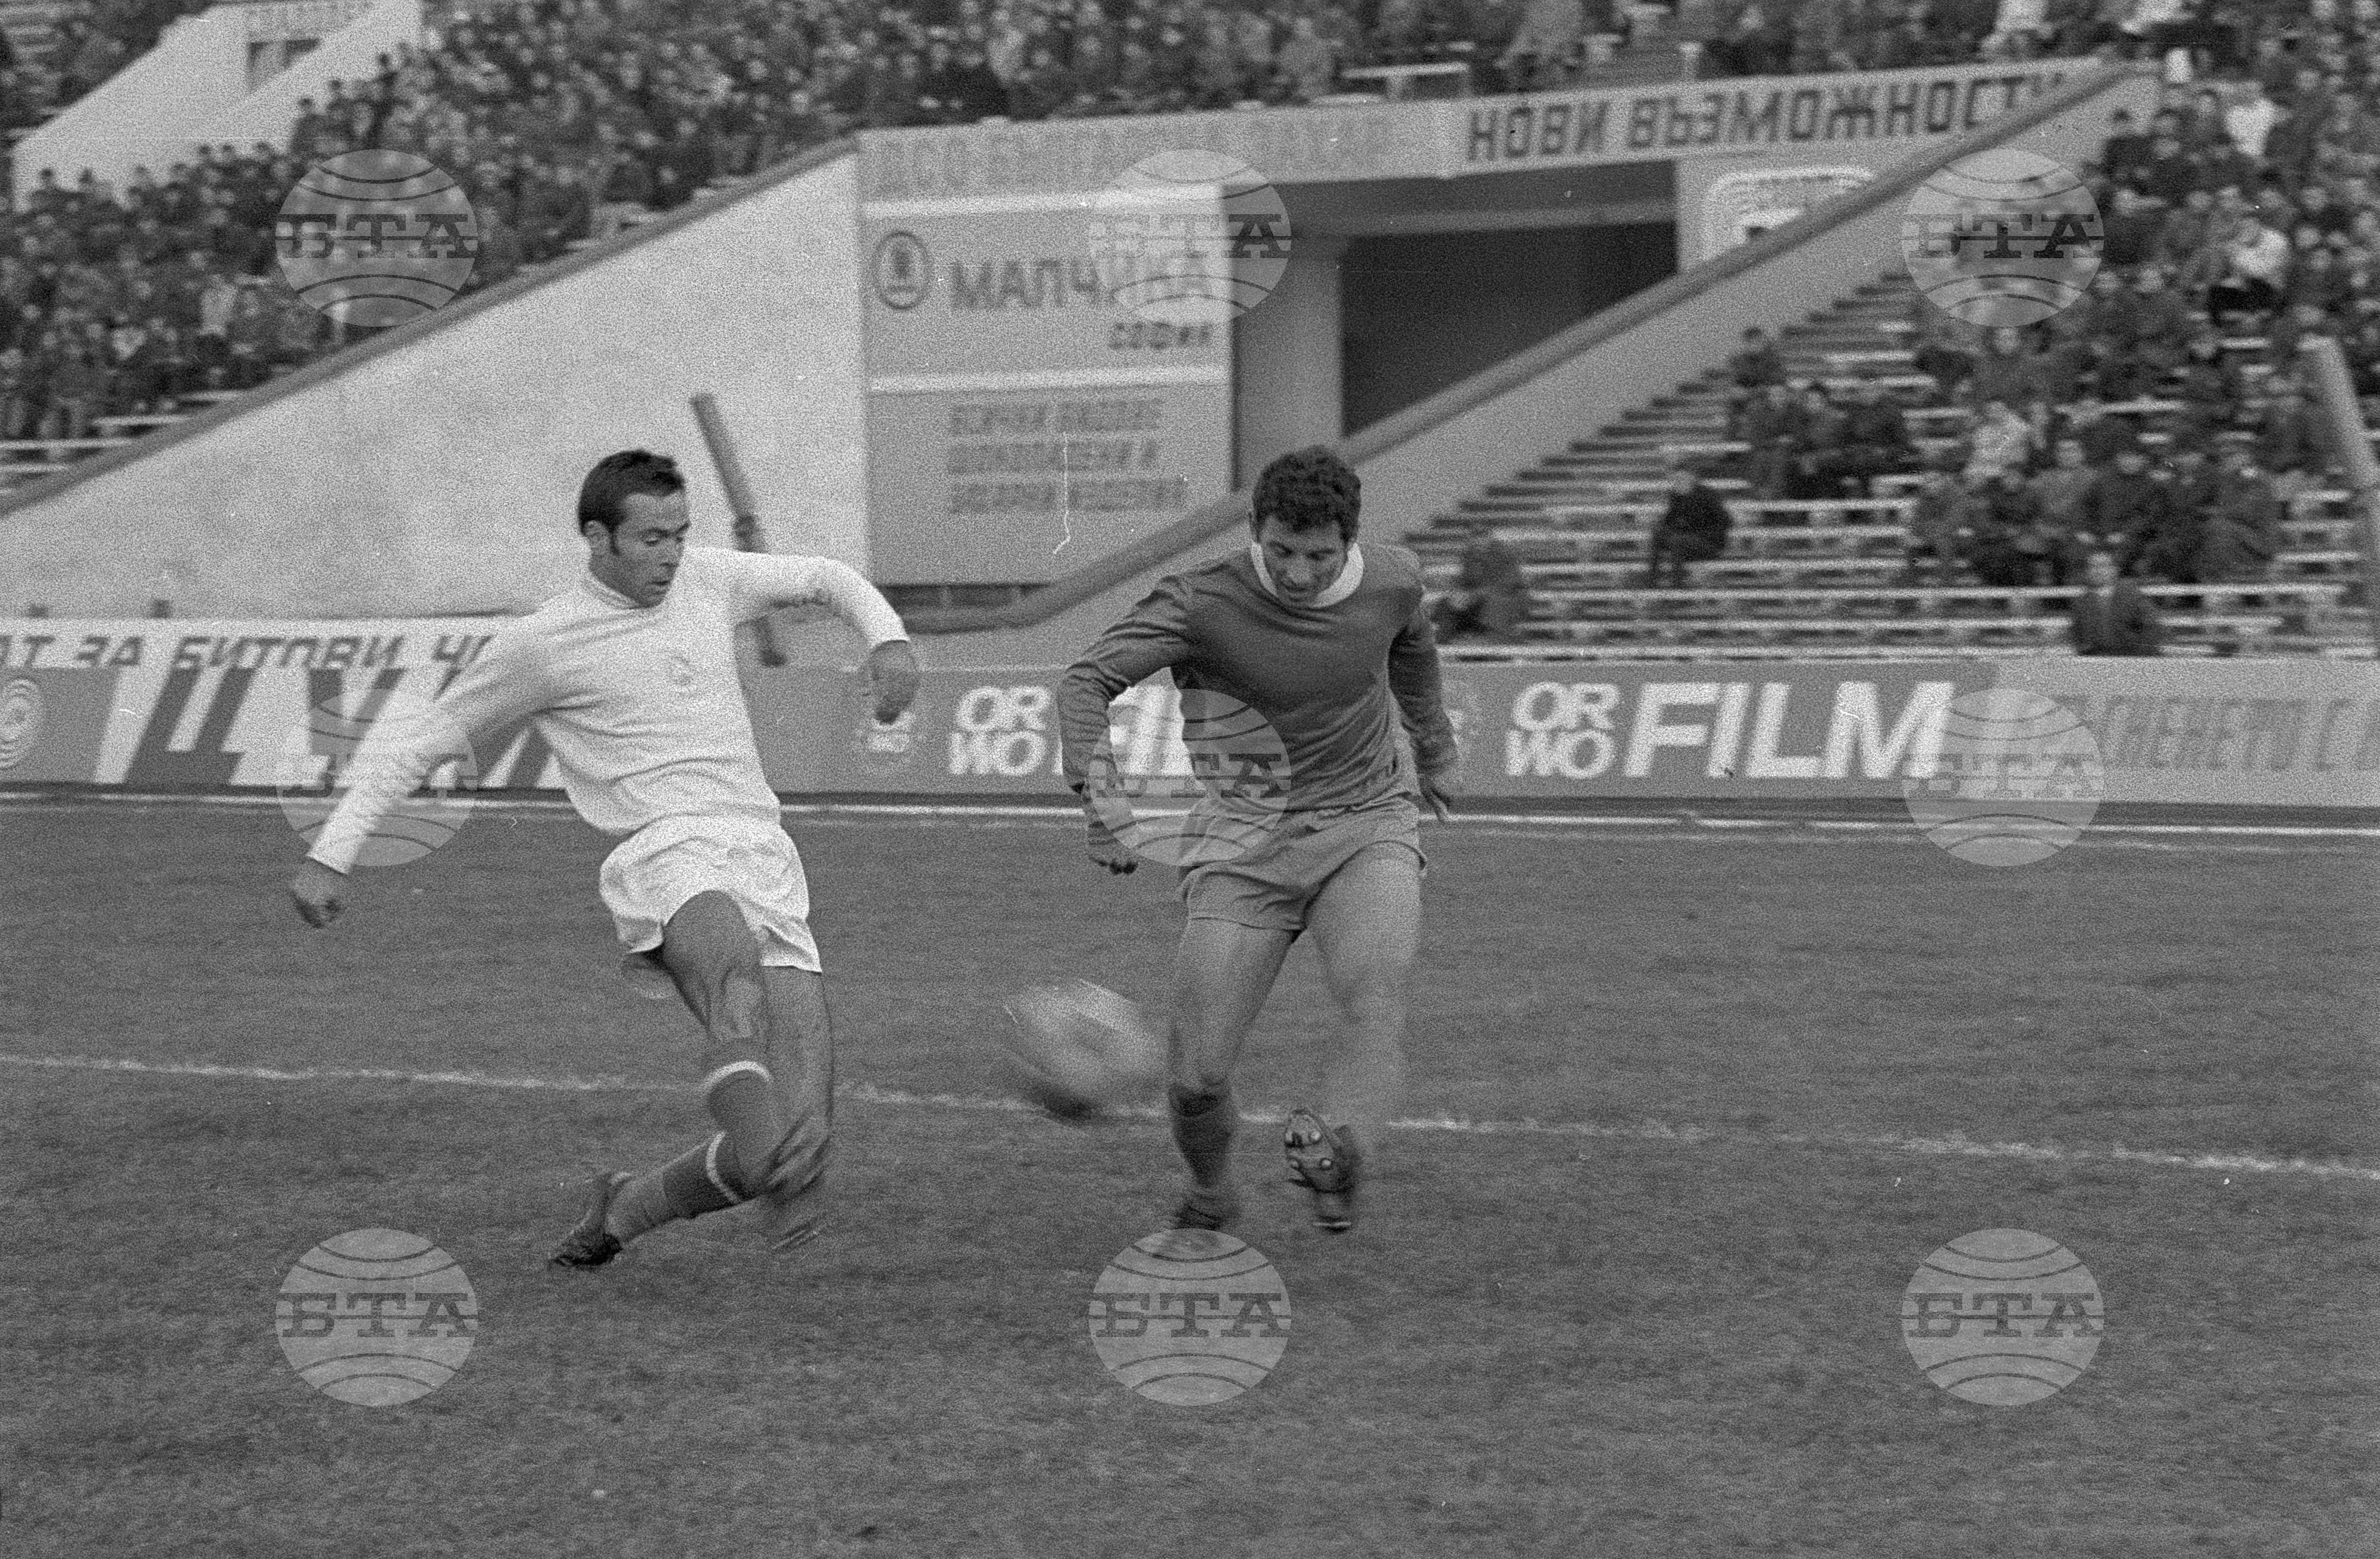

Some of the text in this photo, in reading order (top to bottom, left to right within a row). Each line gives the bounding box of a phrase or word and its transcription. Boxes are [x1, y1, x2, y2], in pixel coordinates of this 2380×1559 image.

[1467, 99, 1610, 162] НОВИ
[77, 635, 145, 667] ЗА
[958, 686, 1051, 731] OR
[1511, 681, 1620, 731] OR
[1623, 681, 1955, 779] FILM
[1505, 729, 1617, 778] WO
